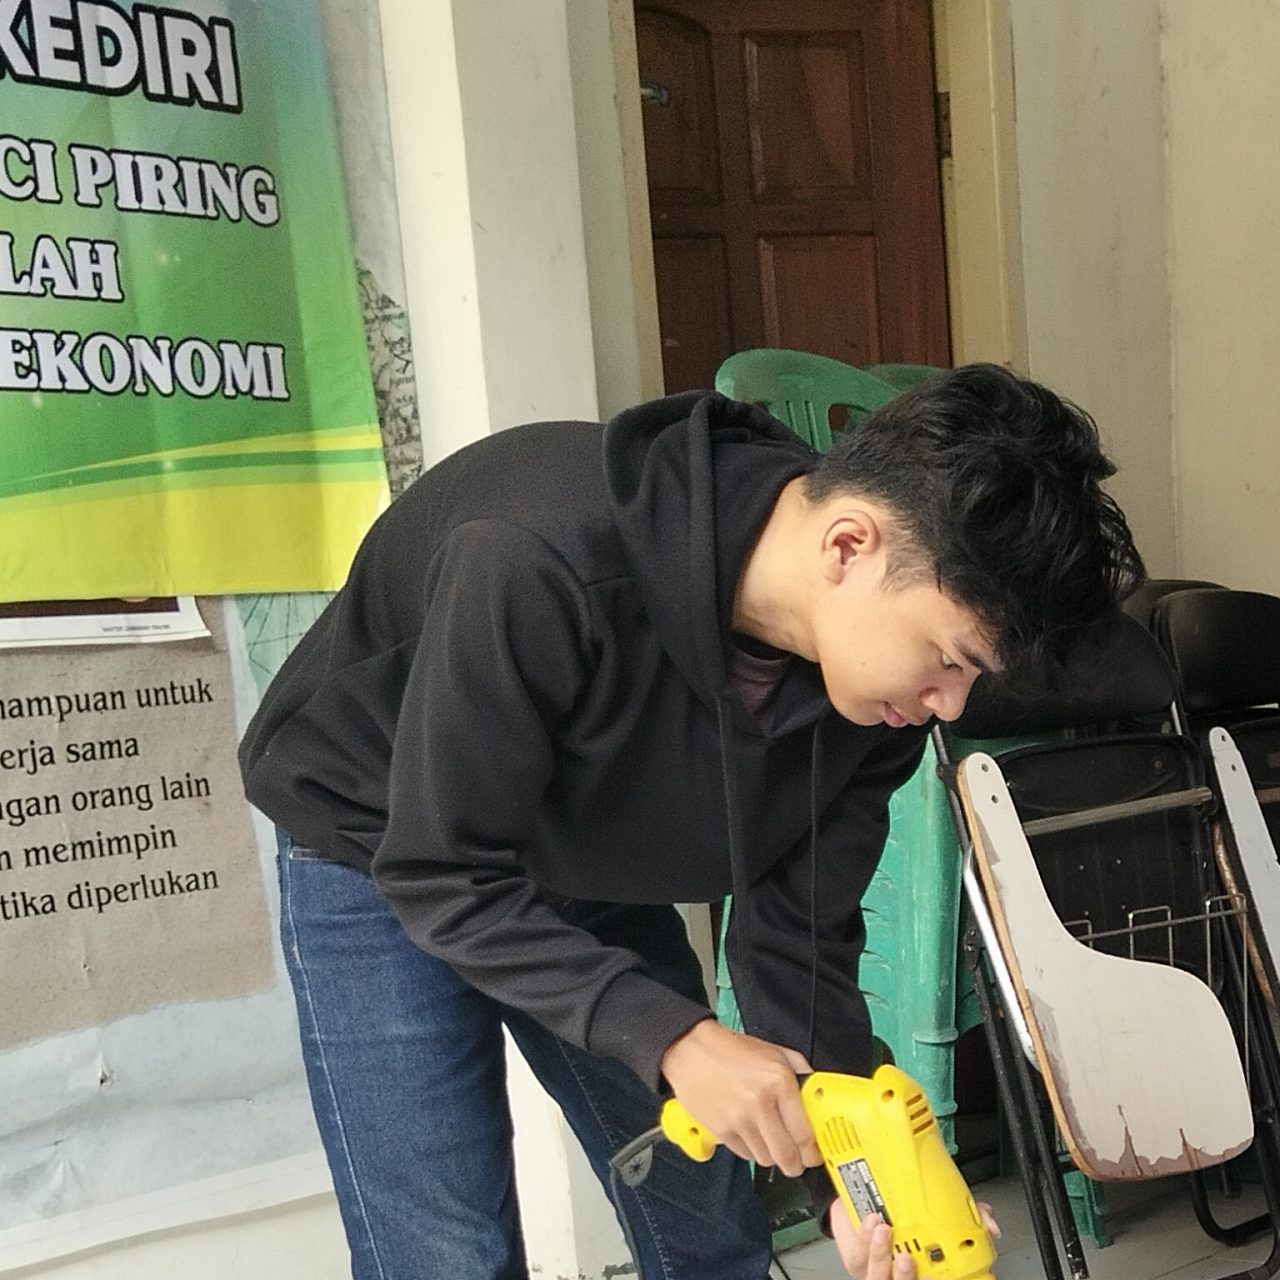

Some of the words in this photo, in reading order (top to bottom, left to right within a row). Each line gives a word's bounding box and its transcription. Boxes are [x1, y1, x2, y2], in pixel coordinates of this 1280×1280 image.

[0, 0, 243, 114] KEDIRI
[69, 143, 280, 227] PIRING
[0, 328, 290, 400] EKONOMI
[136, 678, 214, 709] untuk
[0, 740, 56, 775] erja
[66, 737, 140, 763] sama
[72, 784, 153, 813] orang
[160, 771, 212, 801] lain
[23, 825, 178, 868] memimpin
[0, 890, 57, 921] tika
[67, 868, 219, 912] diperlukan
